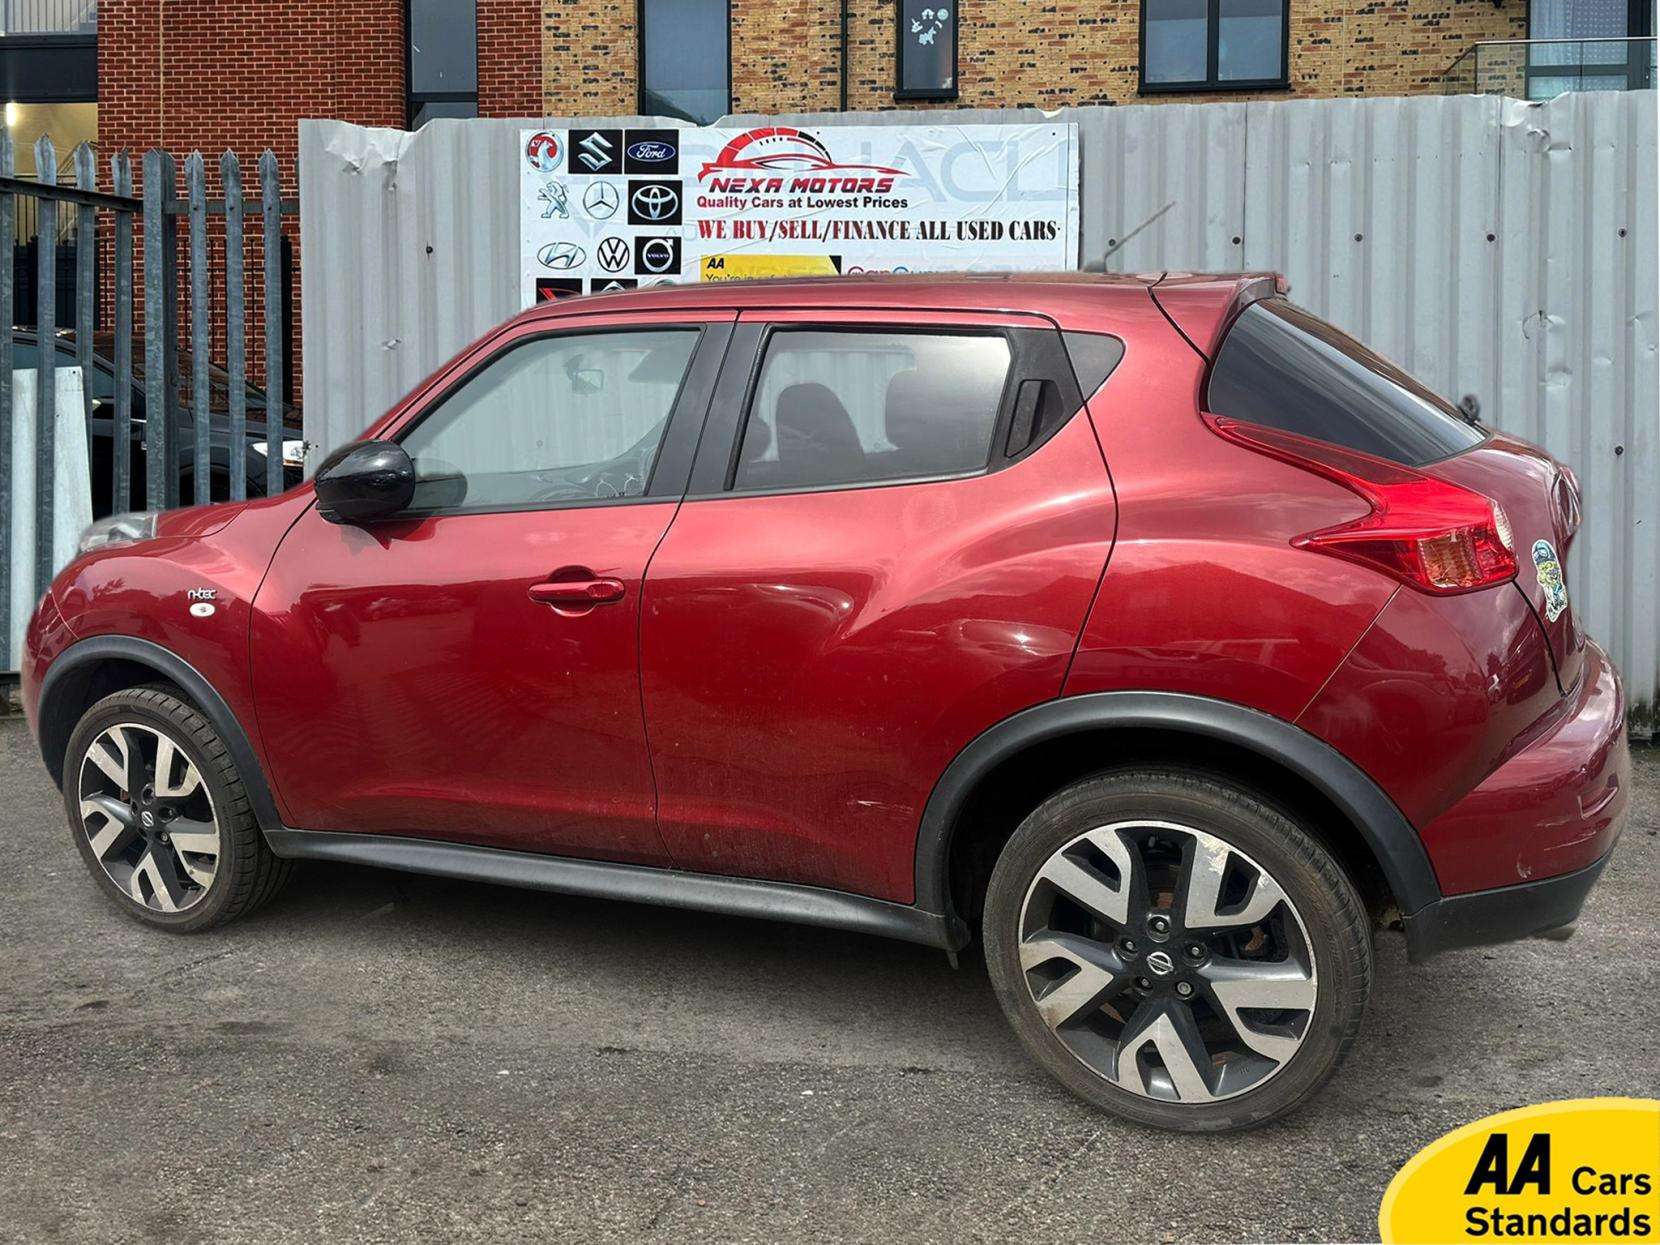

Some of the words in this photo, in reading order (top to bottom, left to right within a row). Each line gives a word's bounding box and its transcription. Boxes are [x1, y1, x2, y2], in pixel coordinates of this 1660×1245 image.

[636, 144, 666, 159] Ford
[709, 177, 783, 194] NEXA
[789, 177, 895, 194] MOTORS
[697, 195, 747, 211] Quality
[751, 195, 784, 209] Cars
[788, 196, 802, 209] at
[807, 196, 859, 209] Lowest
[863, 196, 908, 209] Prices
[697, 219, 727, 240] WE
[732, 219, 911, 242] BUY/SELL/FINANCE
[915, 220, 951, 240] ALL
[956, 220, 1004, 240] USED
[706, 257, 725, 269] AA
